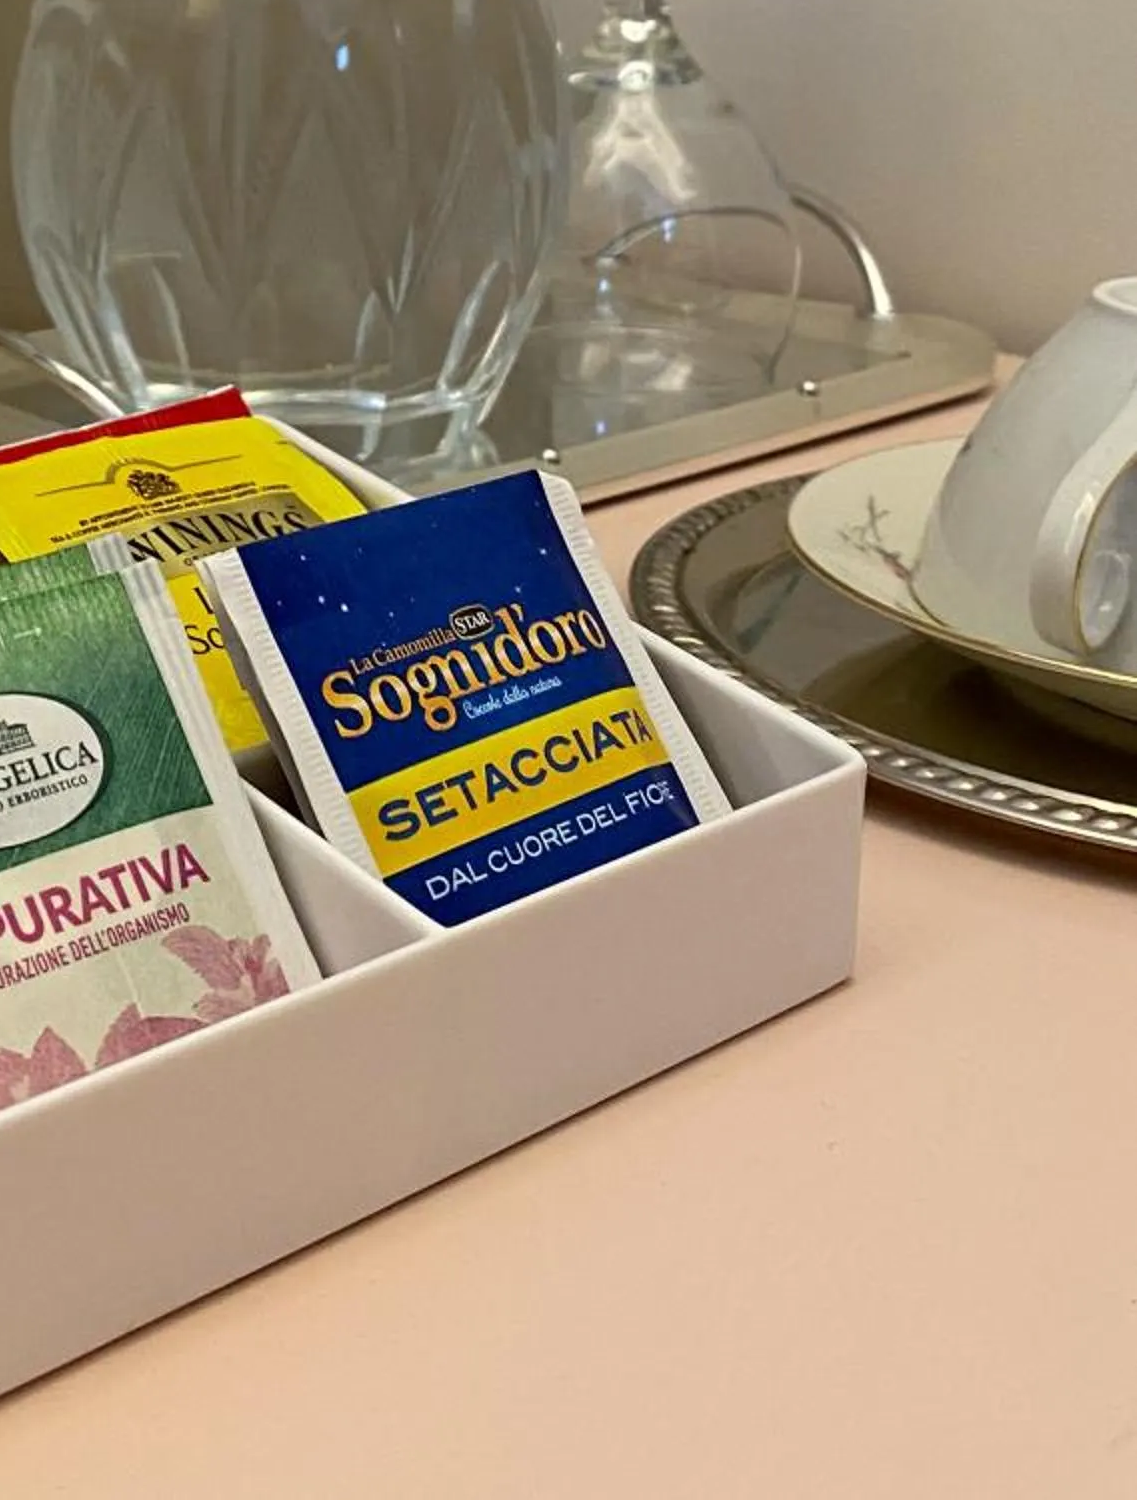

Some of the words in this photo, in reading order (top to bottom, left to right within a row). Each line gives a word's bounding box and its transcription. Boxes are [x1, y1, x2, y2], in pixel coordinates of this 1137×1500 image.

[350, 657, 375, 675] La
[372, 627, 457, 667] Camomilla
[454, 611, 491, 634] STAR
[7, 773, 89, 808] ERBORISTICO
[377, 708, 653, 842] SETACCIATA
[425, 862, 488, 901] DAL
[487, 820, 579, 874] CUORE
[576, 802, 628, 836] DEL
[69, 901, 191, 962] DELL'ORGANISMO
